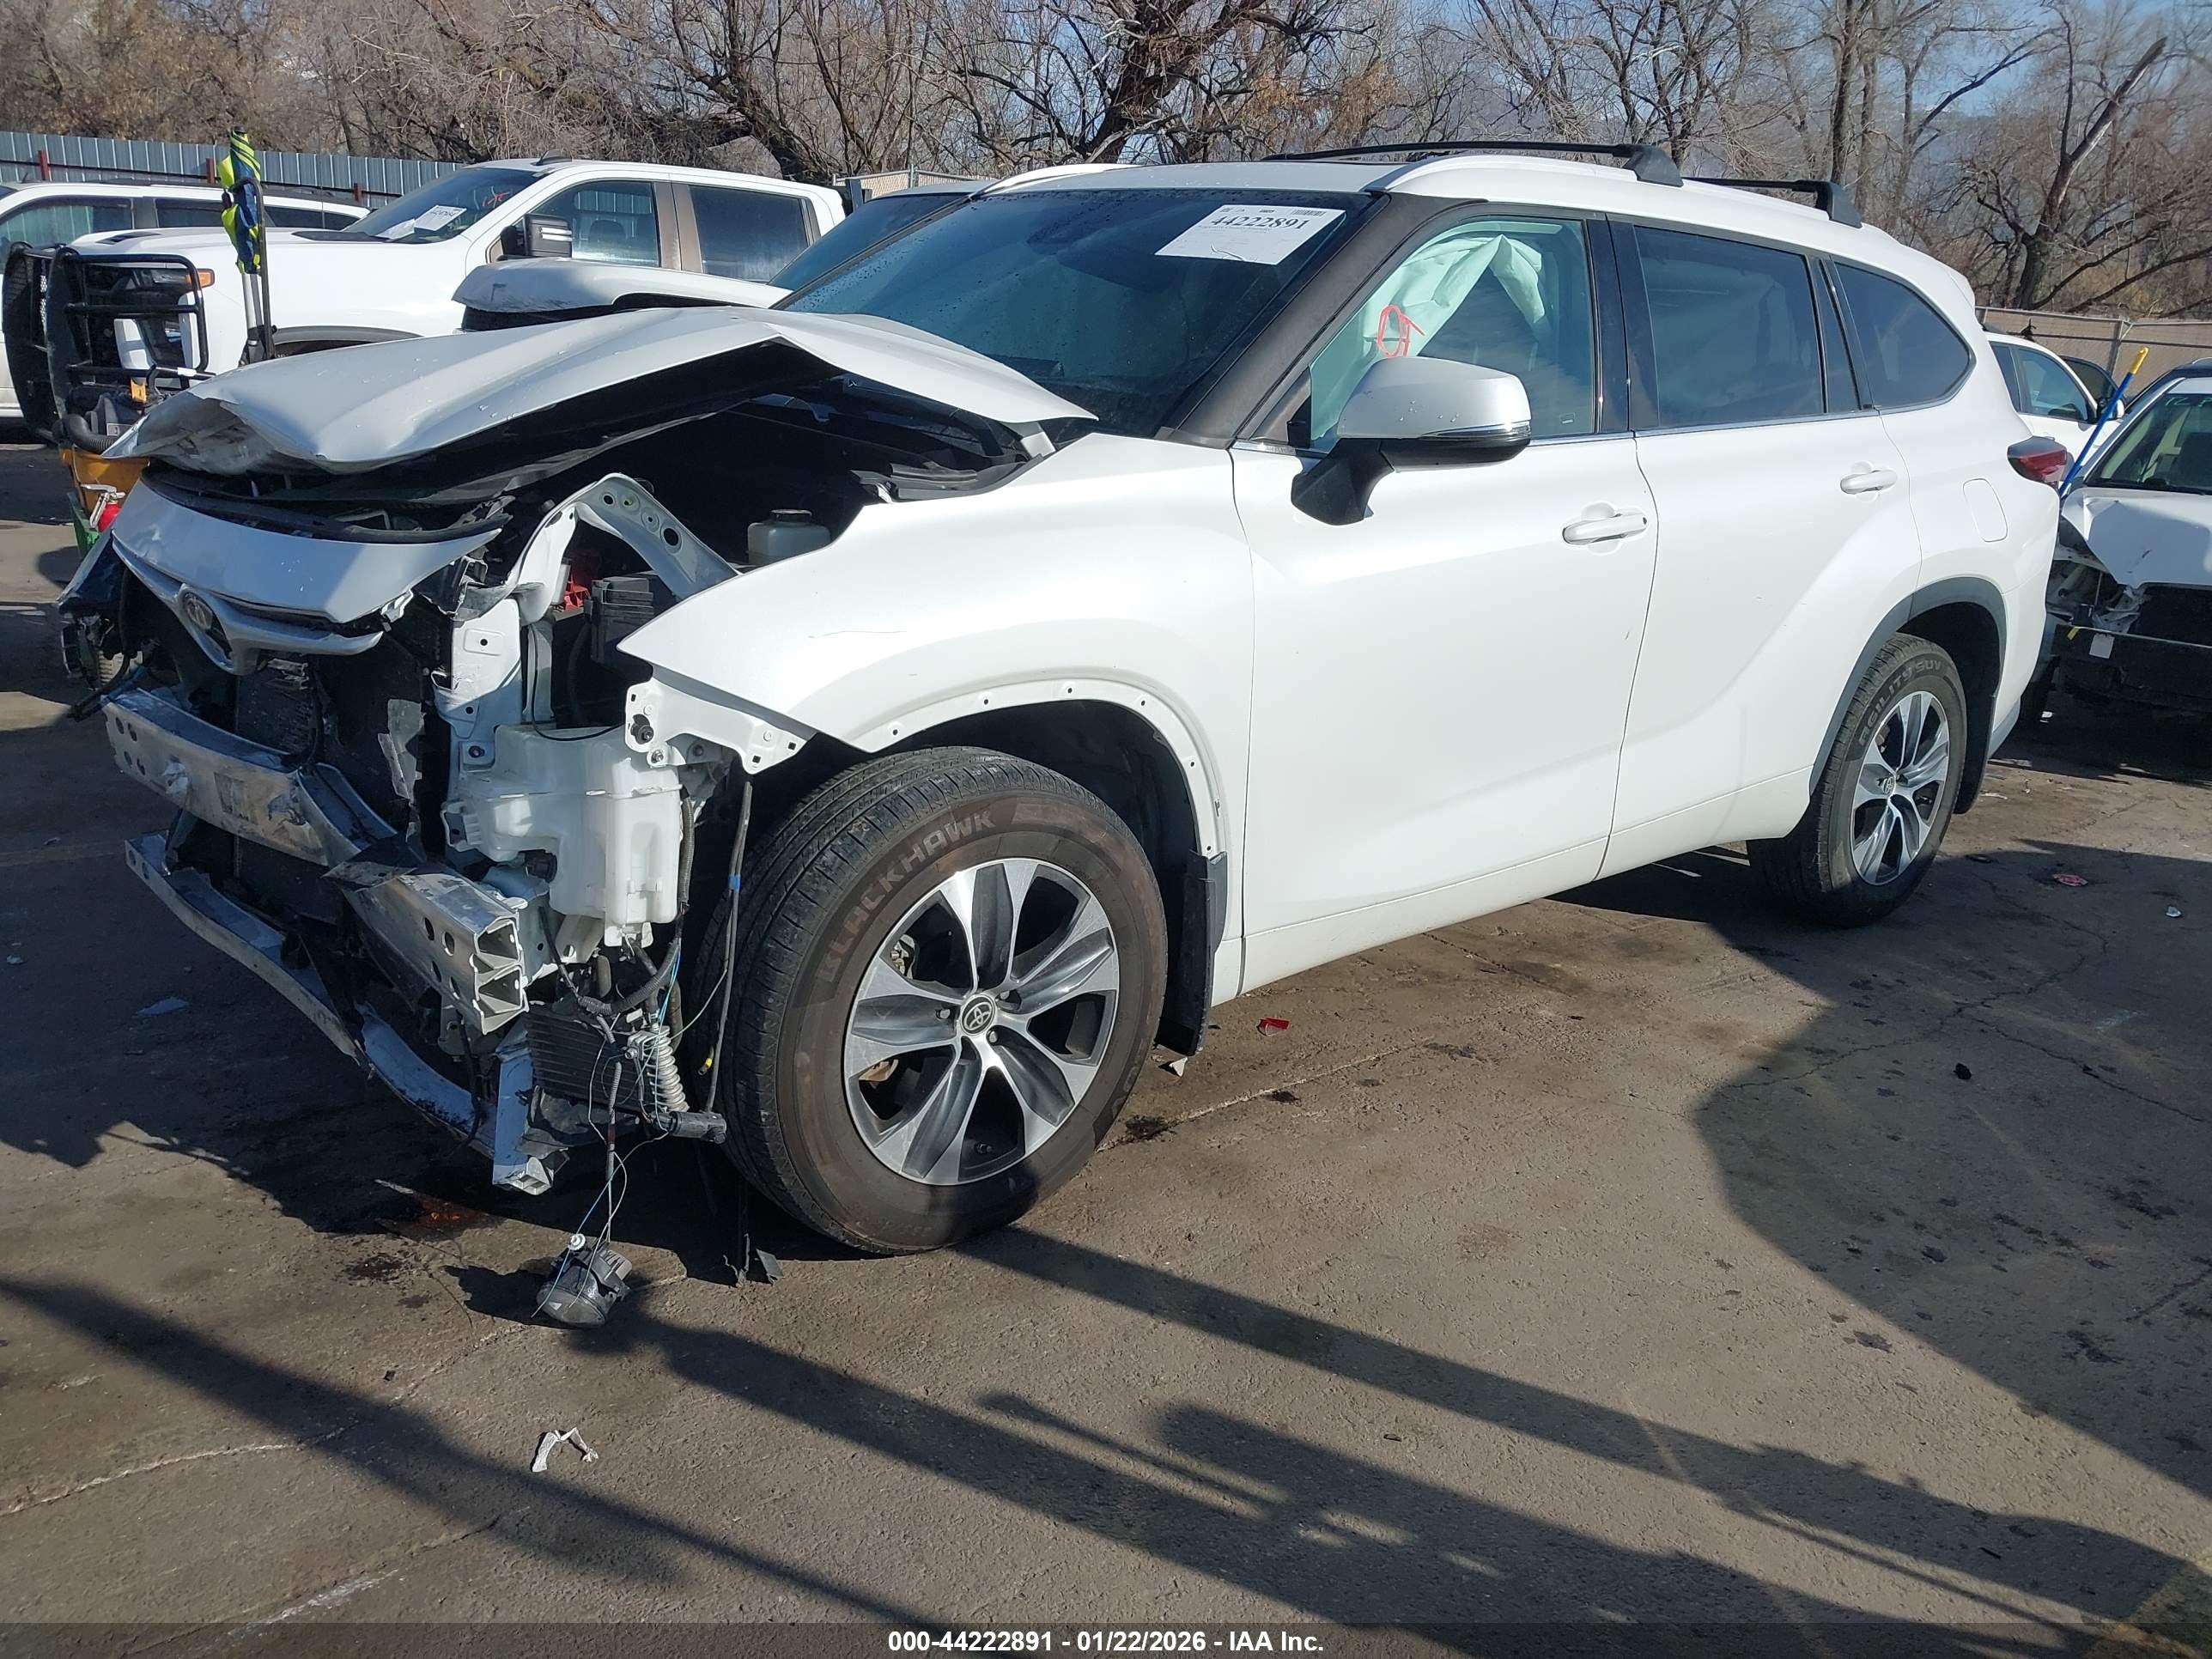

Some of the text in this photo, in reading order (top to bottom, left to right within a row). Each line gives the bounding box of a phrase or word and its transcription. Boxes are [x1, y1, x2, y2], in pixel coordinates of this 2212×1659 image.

[1211, 216, 1310, 229] 44222891
[1915, 659, 1942, 672] SUV
[817, 810, 996, 982] BLACKHAWK
